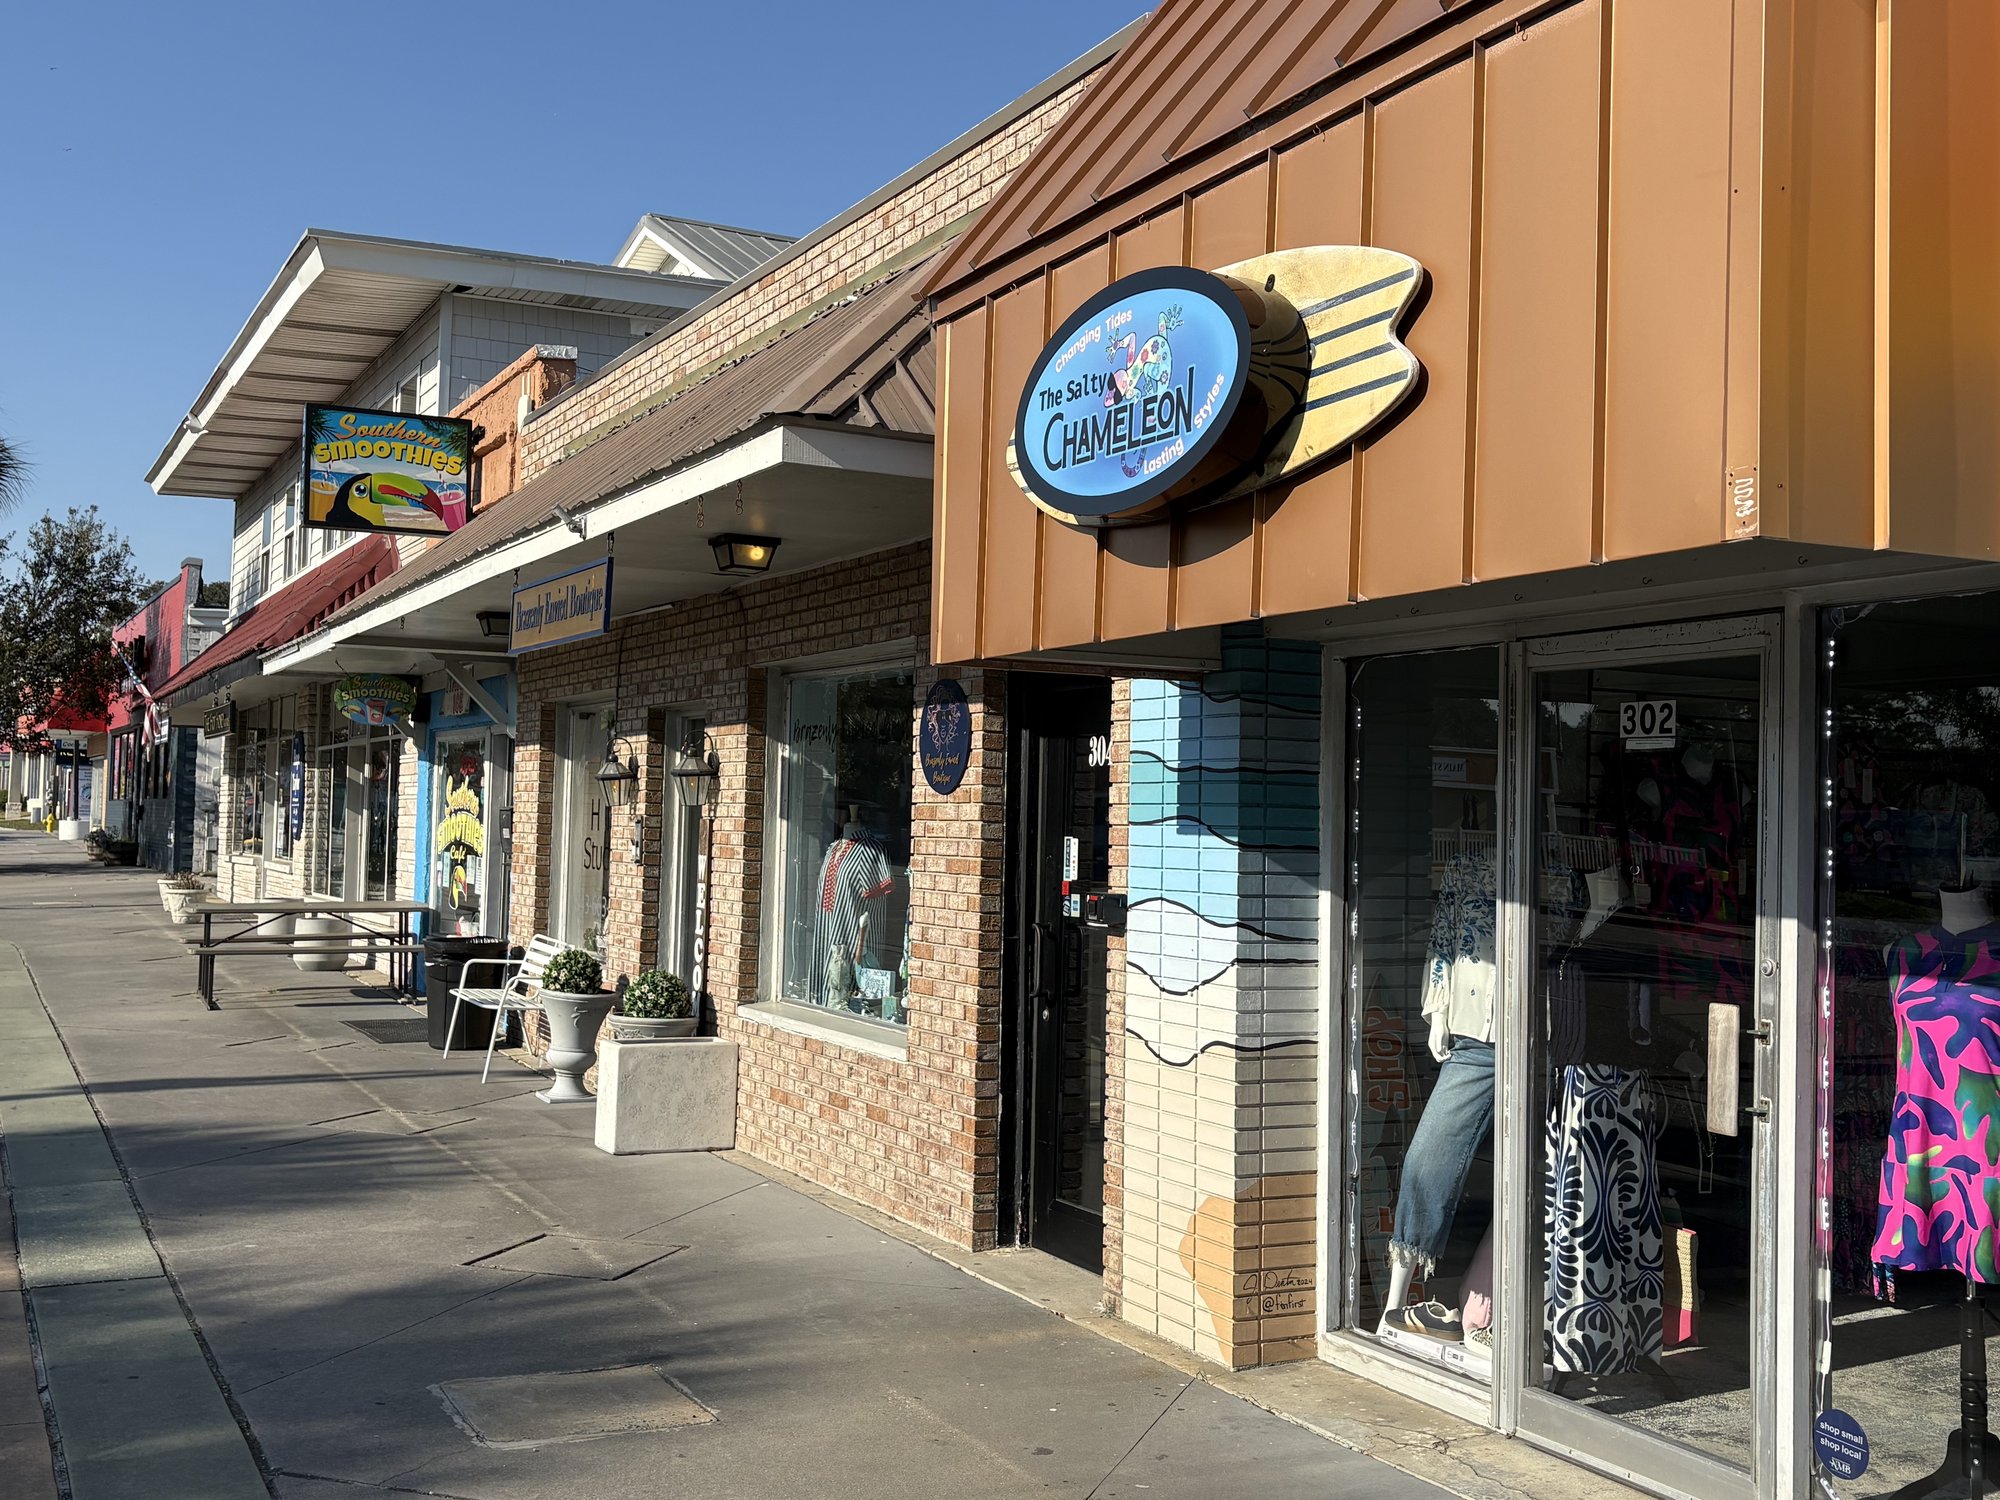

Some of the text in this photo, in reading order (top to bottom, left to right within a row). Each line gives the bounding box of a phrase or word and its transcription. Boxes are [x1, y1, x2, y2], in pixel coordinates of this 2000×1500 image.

[1055, 309, 1133, 373] Changing Tides
[1039, 372, 1108, 412] The Salty
[335, 413, 442, 448] Southern
[1143, 437, 1185, 475] Lasting
[515, 578, 604, 634] Brazenly Envied Boutique
[351, 676, 401, 691] Southern
[793, 715, 838, 753] Brazenly
[1622, 702, 1674, 736] 302
[1362, 1005, 1412, 1114] SHOP
[1820, 1421, 1863, 1445] shop small
[1820, 1437, 1862, 1461] shop local
